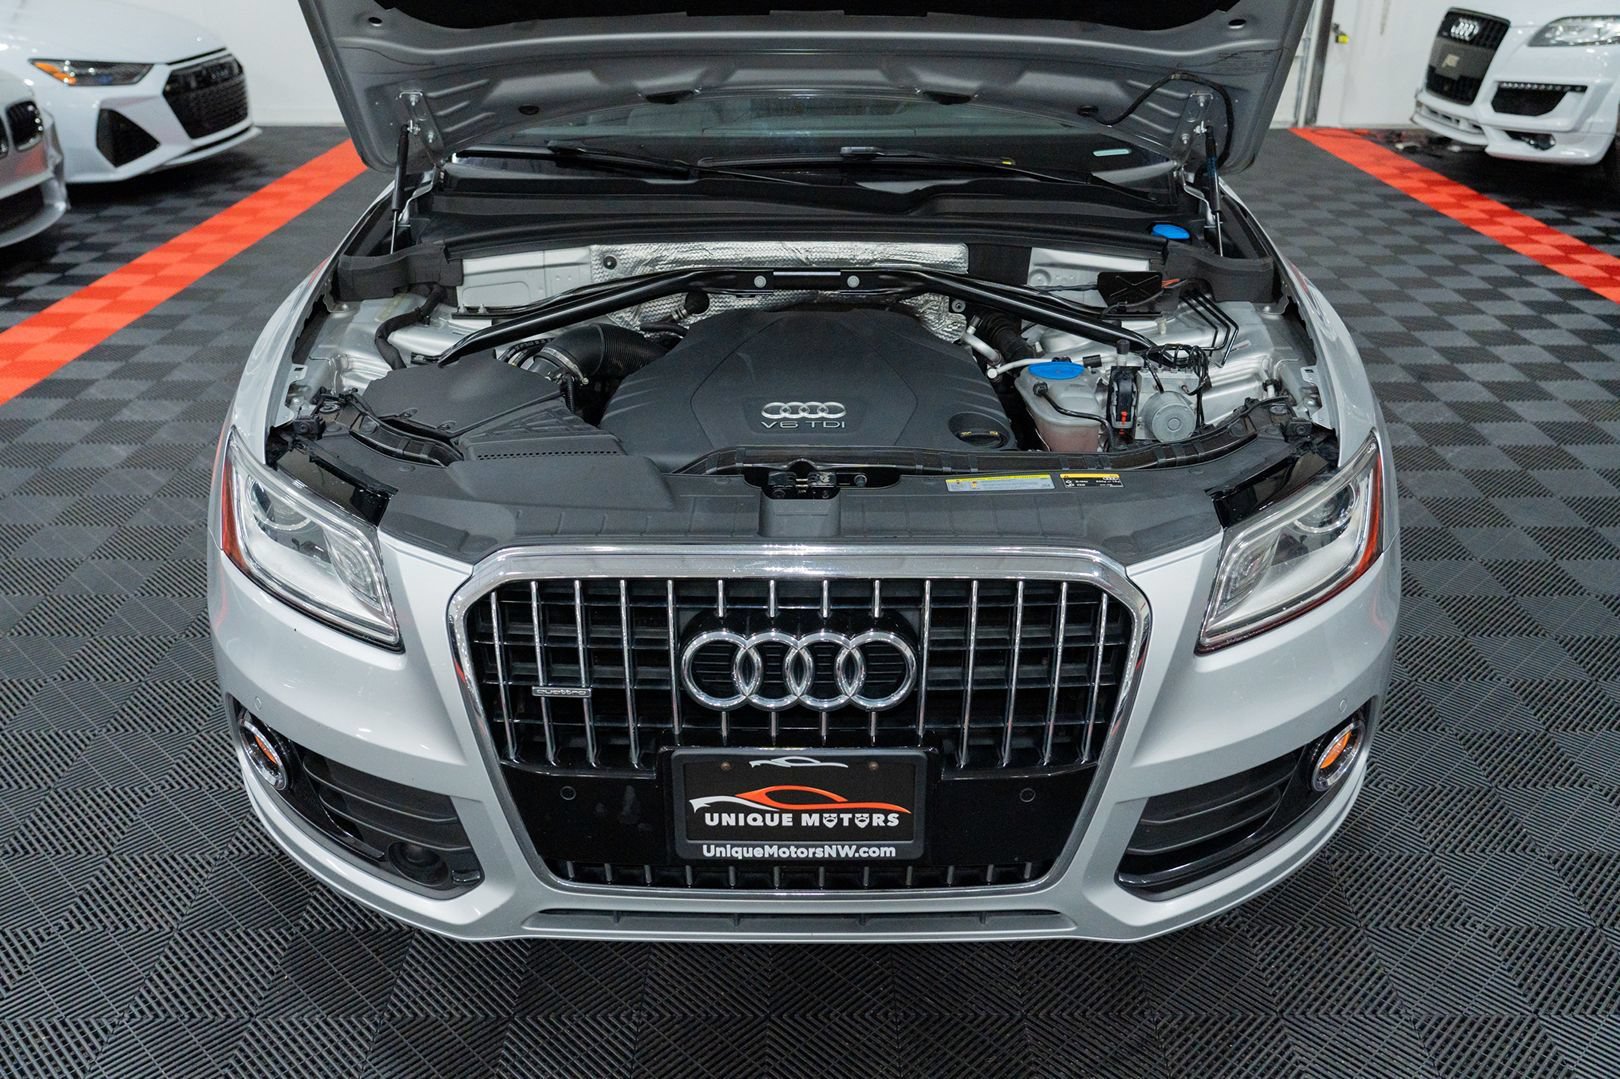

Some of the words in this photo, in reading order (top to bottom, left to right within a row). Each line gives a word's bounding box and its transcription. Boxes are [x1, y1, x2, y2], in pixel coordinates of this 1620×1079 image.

[761, 420, 799, 429] V6
[804, 420, 846, 429] TDI
[704, 812, 794, 827] UNIQUE
[800, 812, 900, 828] MOTORS
[702, 844, 897, 860] UniqueMotorsNW.com
